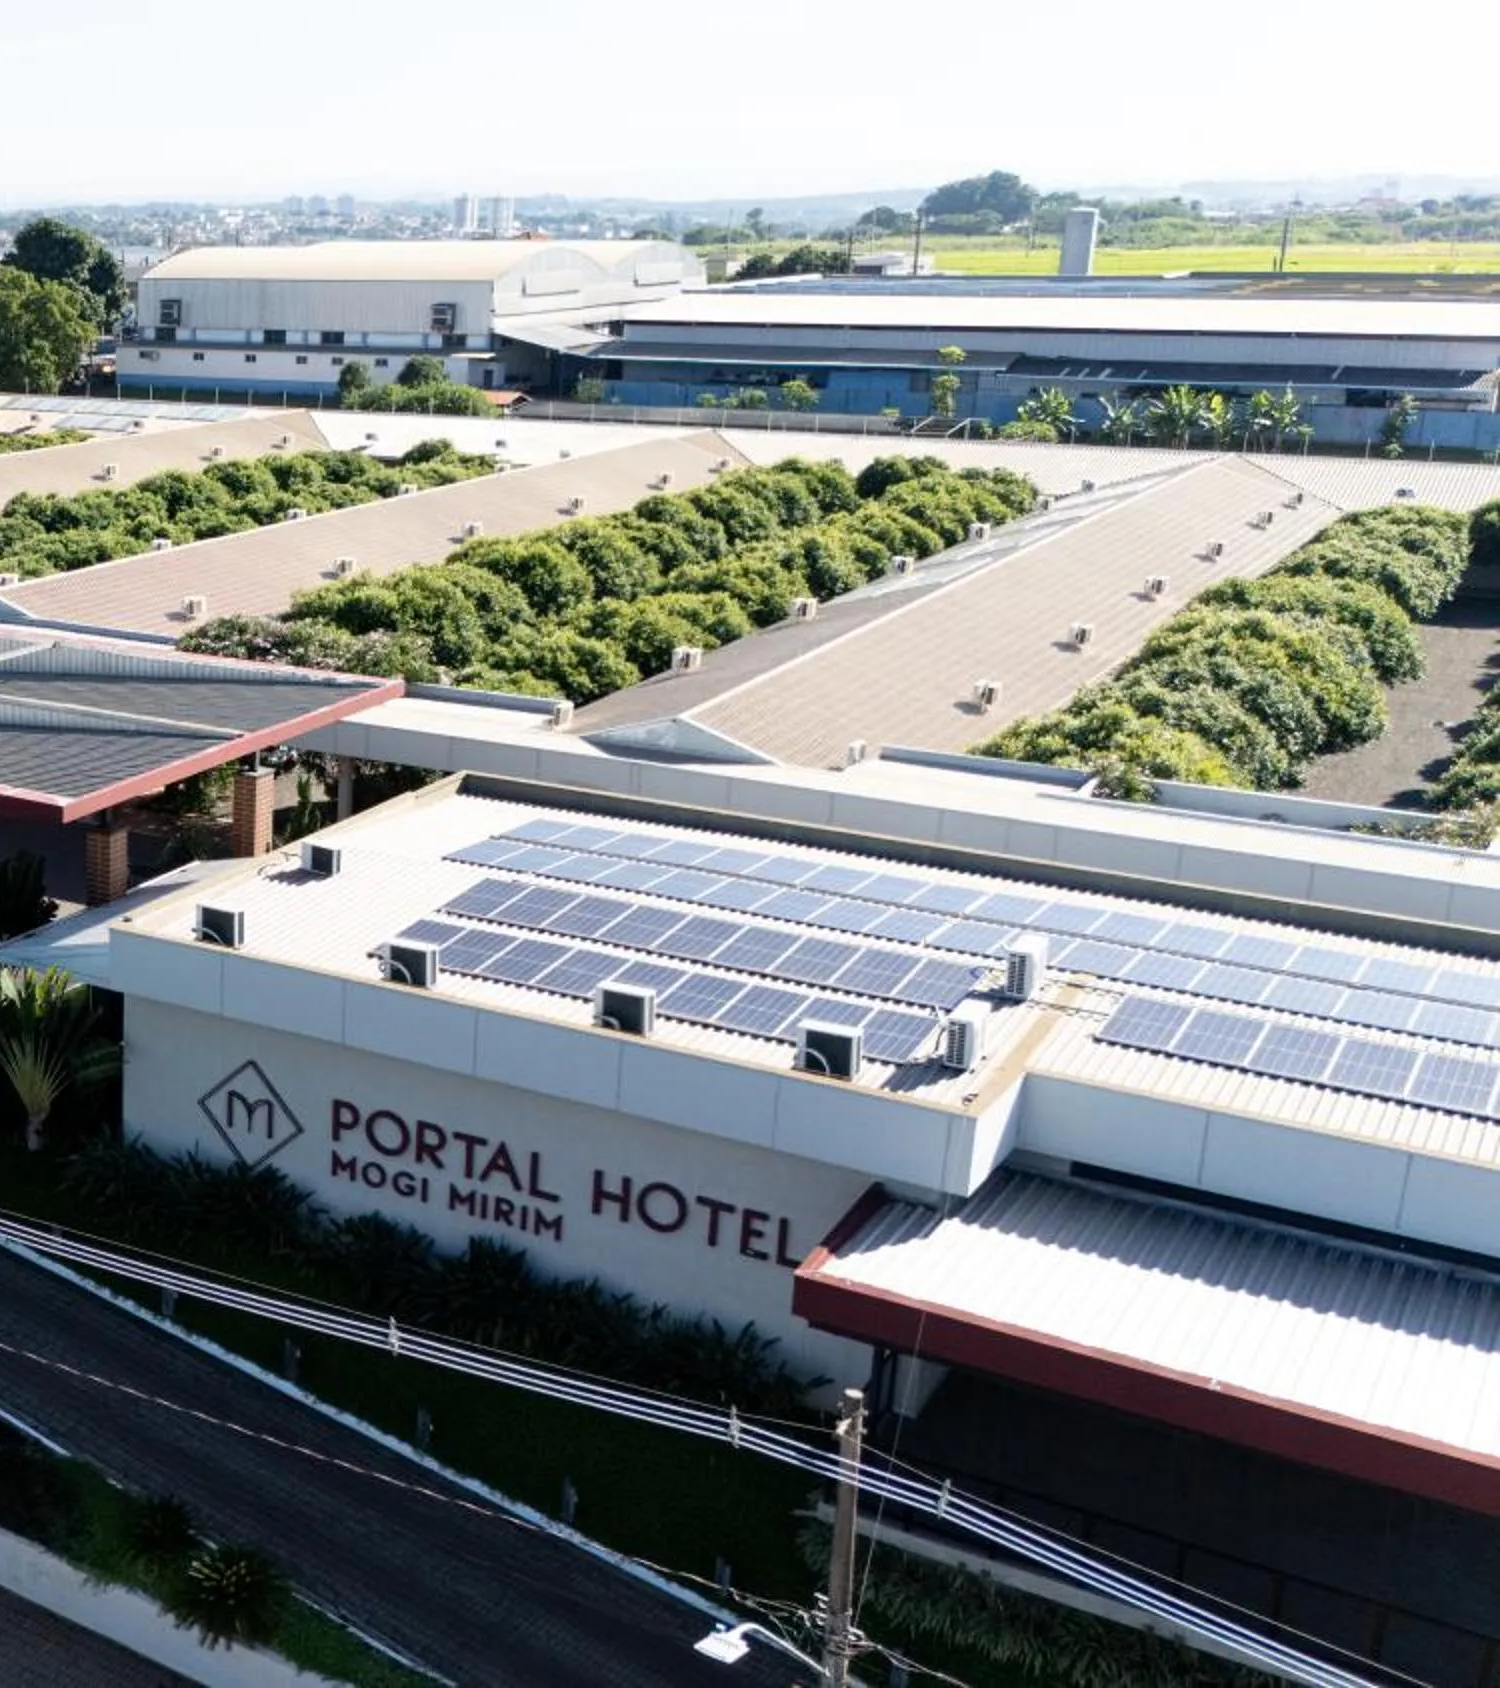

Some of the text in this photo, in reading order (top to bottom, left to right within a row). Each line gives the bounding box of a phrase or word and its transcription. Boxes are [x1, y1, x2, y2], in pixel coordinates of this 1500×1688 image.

[330, 1149, 564, 1242] MOGI MIRIM
[331, 1099, 803, 1268] PORTAL HOTEL
